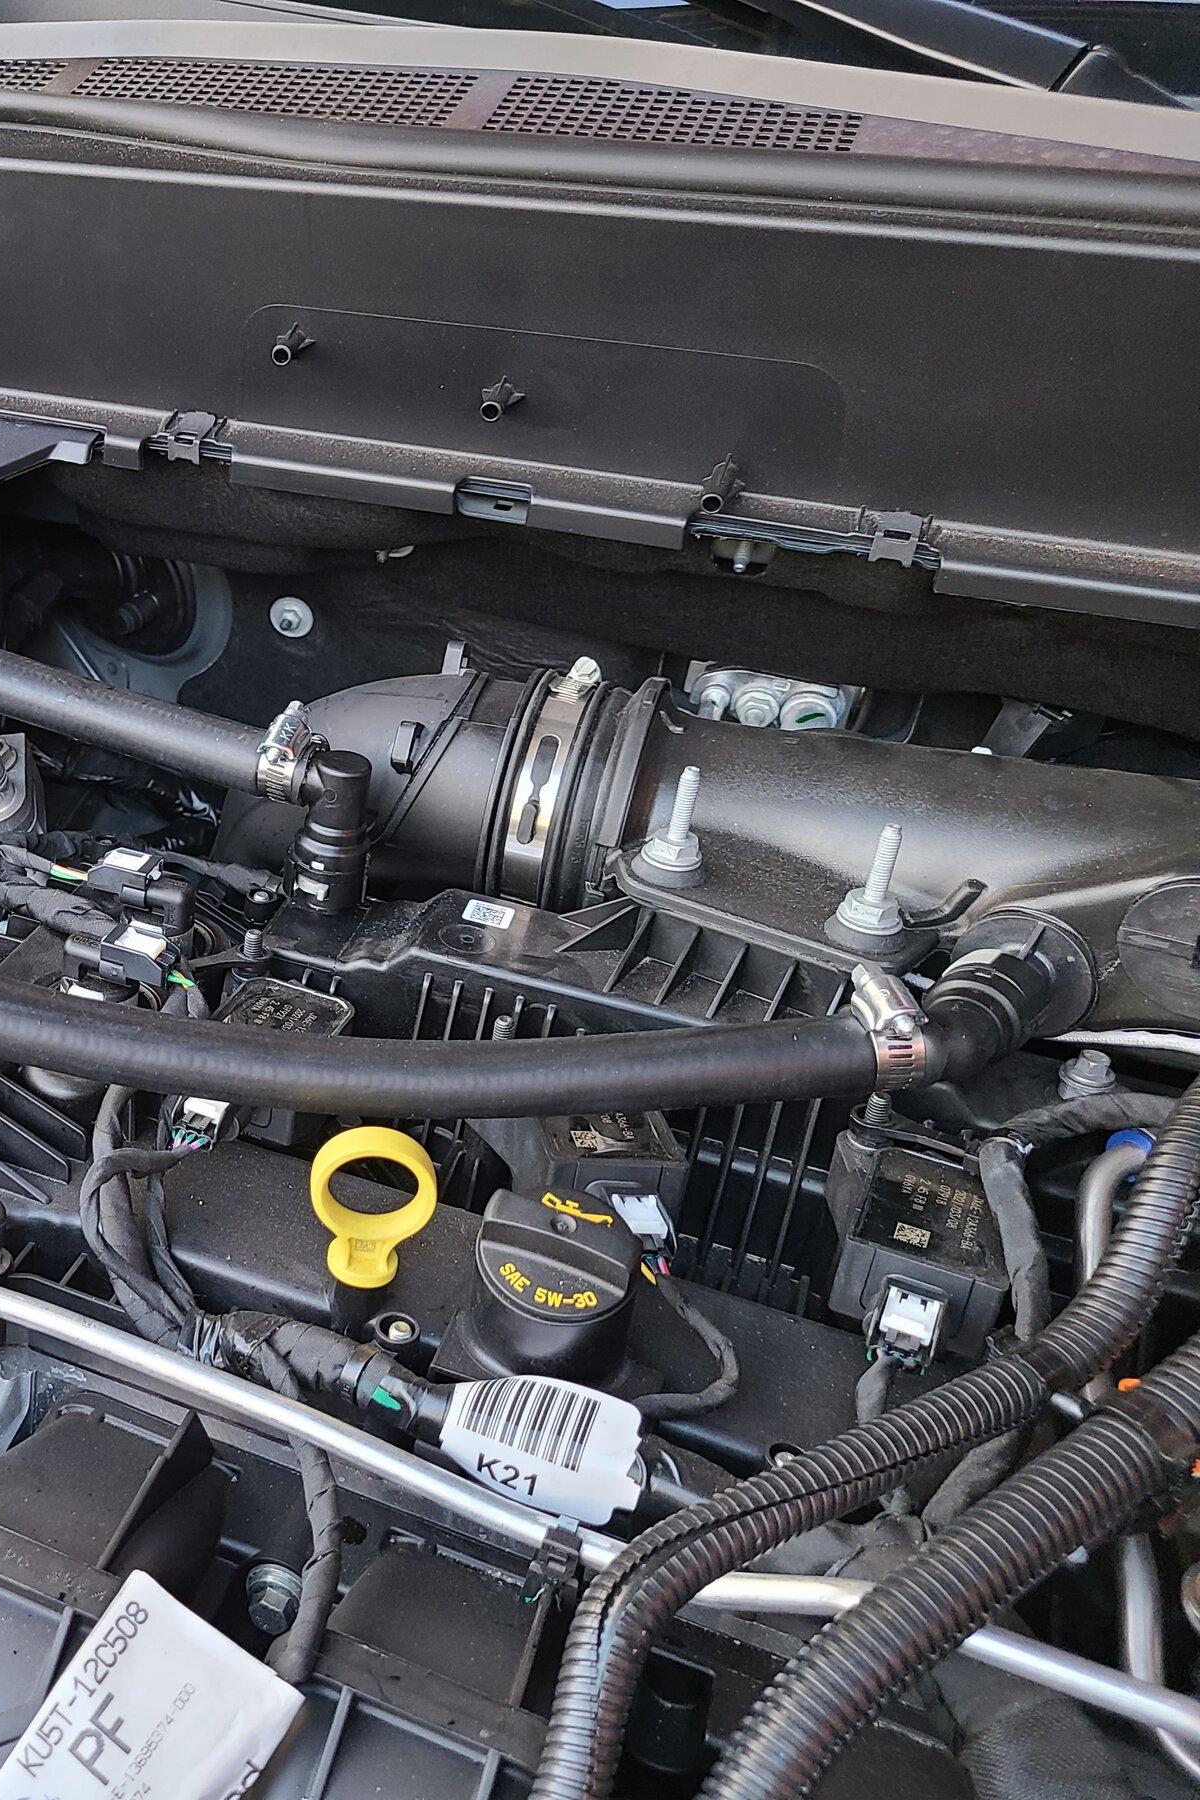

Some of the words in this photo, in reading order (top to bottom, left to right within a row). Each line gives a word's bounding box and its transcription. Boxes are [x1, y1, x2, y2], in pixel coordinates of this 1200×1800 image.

[946, 1189, 966, 1230] 2021/03/08
[499, 1262, 531, 1293] SAE
[534, 1286, 598, 1310] 5W-30
[477, 1452, 538, 1496] K21
[16, 1600, 150, 1777] KU5T-12C508
[68, 1692, 132, 1786] PF
